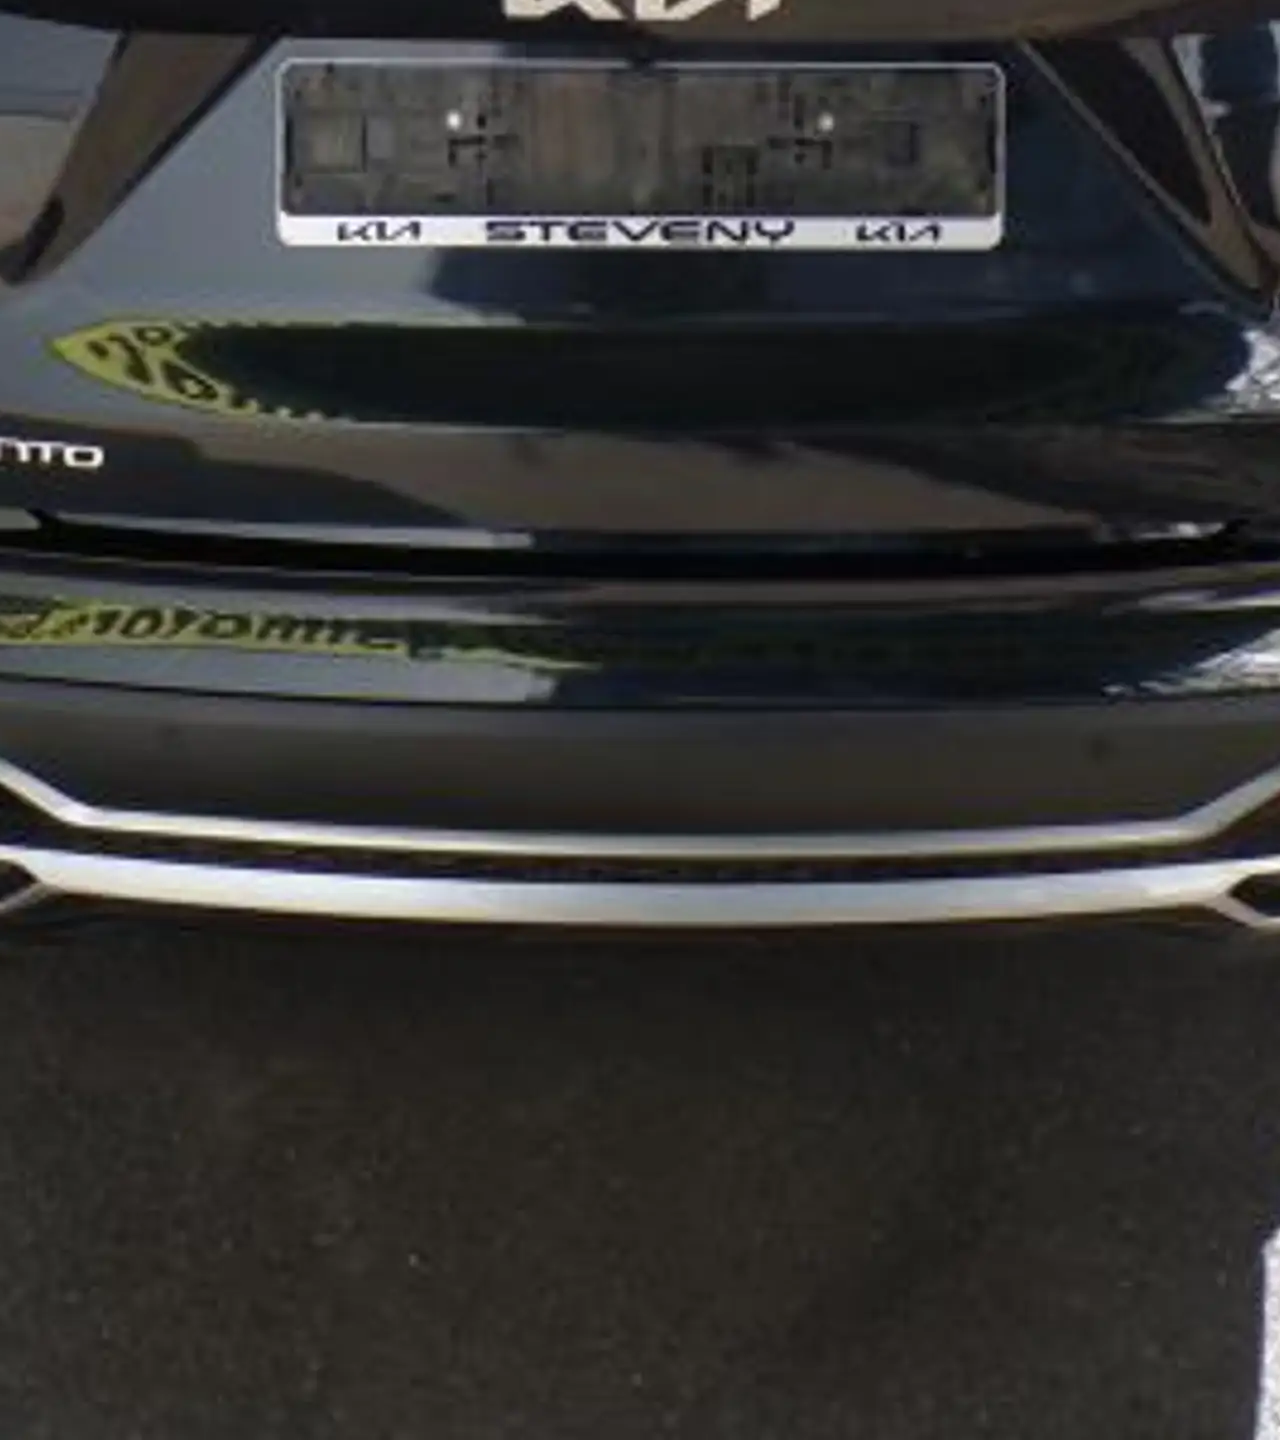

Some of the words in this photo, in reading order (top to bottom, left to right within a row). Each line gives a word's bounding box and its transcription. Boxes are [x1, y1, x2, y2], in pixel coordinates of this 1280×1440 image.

[336, 221, 422, 242] KIA
[485, 220, 796, 243] STEVENY
[856, 221, 943, 243] KIA
